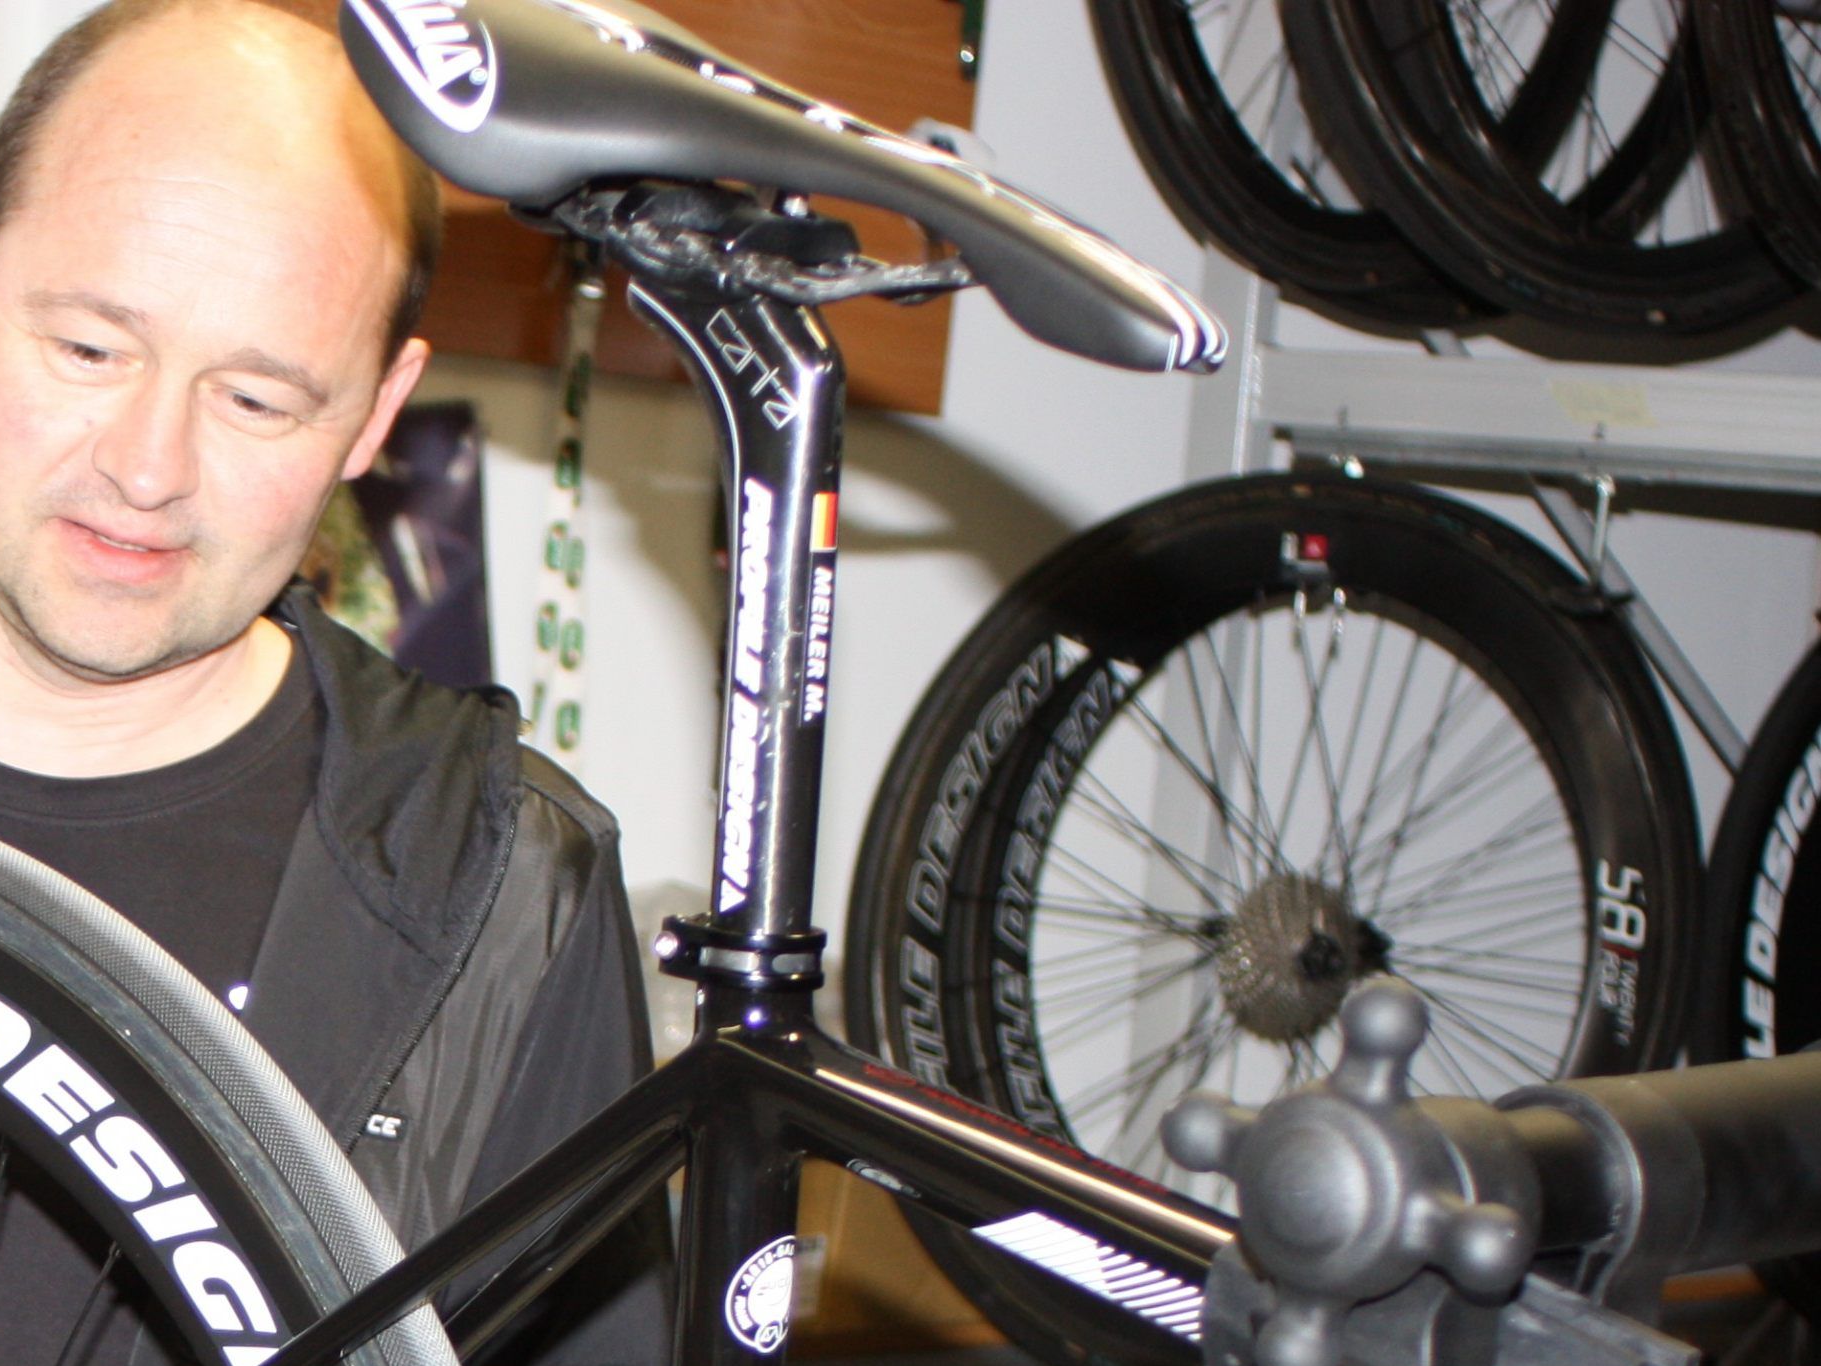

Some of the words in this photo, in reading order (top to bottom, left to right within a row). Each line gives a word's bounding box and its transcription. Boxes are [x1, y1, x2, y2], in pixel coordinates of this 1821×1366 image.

[735, 477, 773, 695] PROFILE
[805, 566, 833, 680] MEILER
[722, 703, 762, 889] DESIGN
[907, 643, 1054, 934] DESIGN
[1596, 857, 1647, 951] 58
